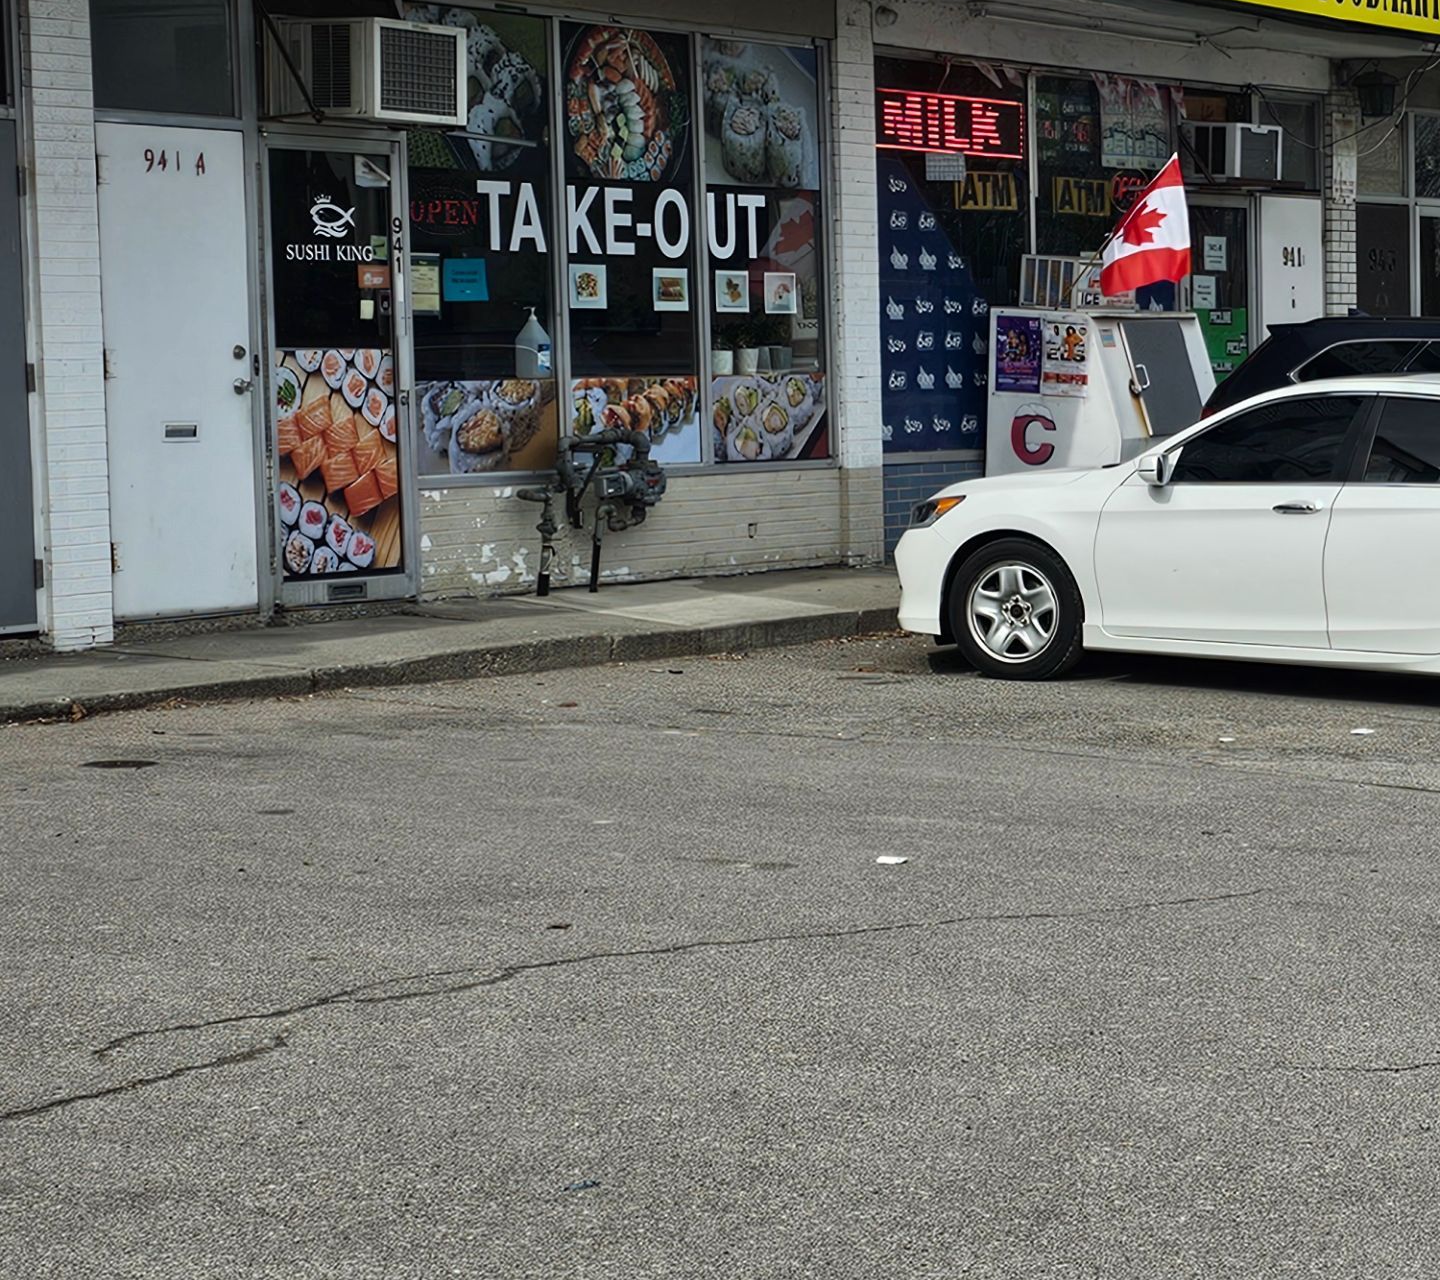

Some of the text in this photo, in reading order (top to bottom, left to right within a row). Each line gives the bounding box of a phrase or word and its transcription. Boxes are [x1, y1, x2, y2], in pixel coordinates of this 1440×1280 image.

[883, 95, 1001, 151] MILK
[143, 148, 206, 176] 941 A
[961, 172, 1013, 208] ATM
[410, 199, 481, 226] OPEN
[286, 243, 373, 263] SUSHI KING
[1081, 292, 1100, 306] ICE
